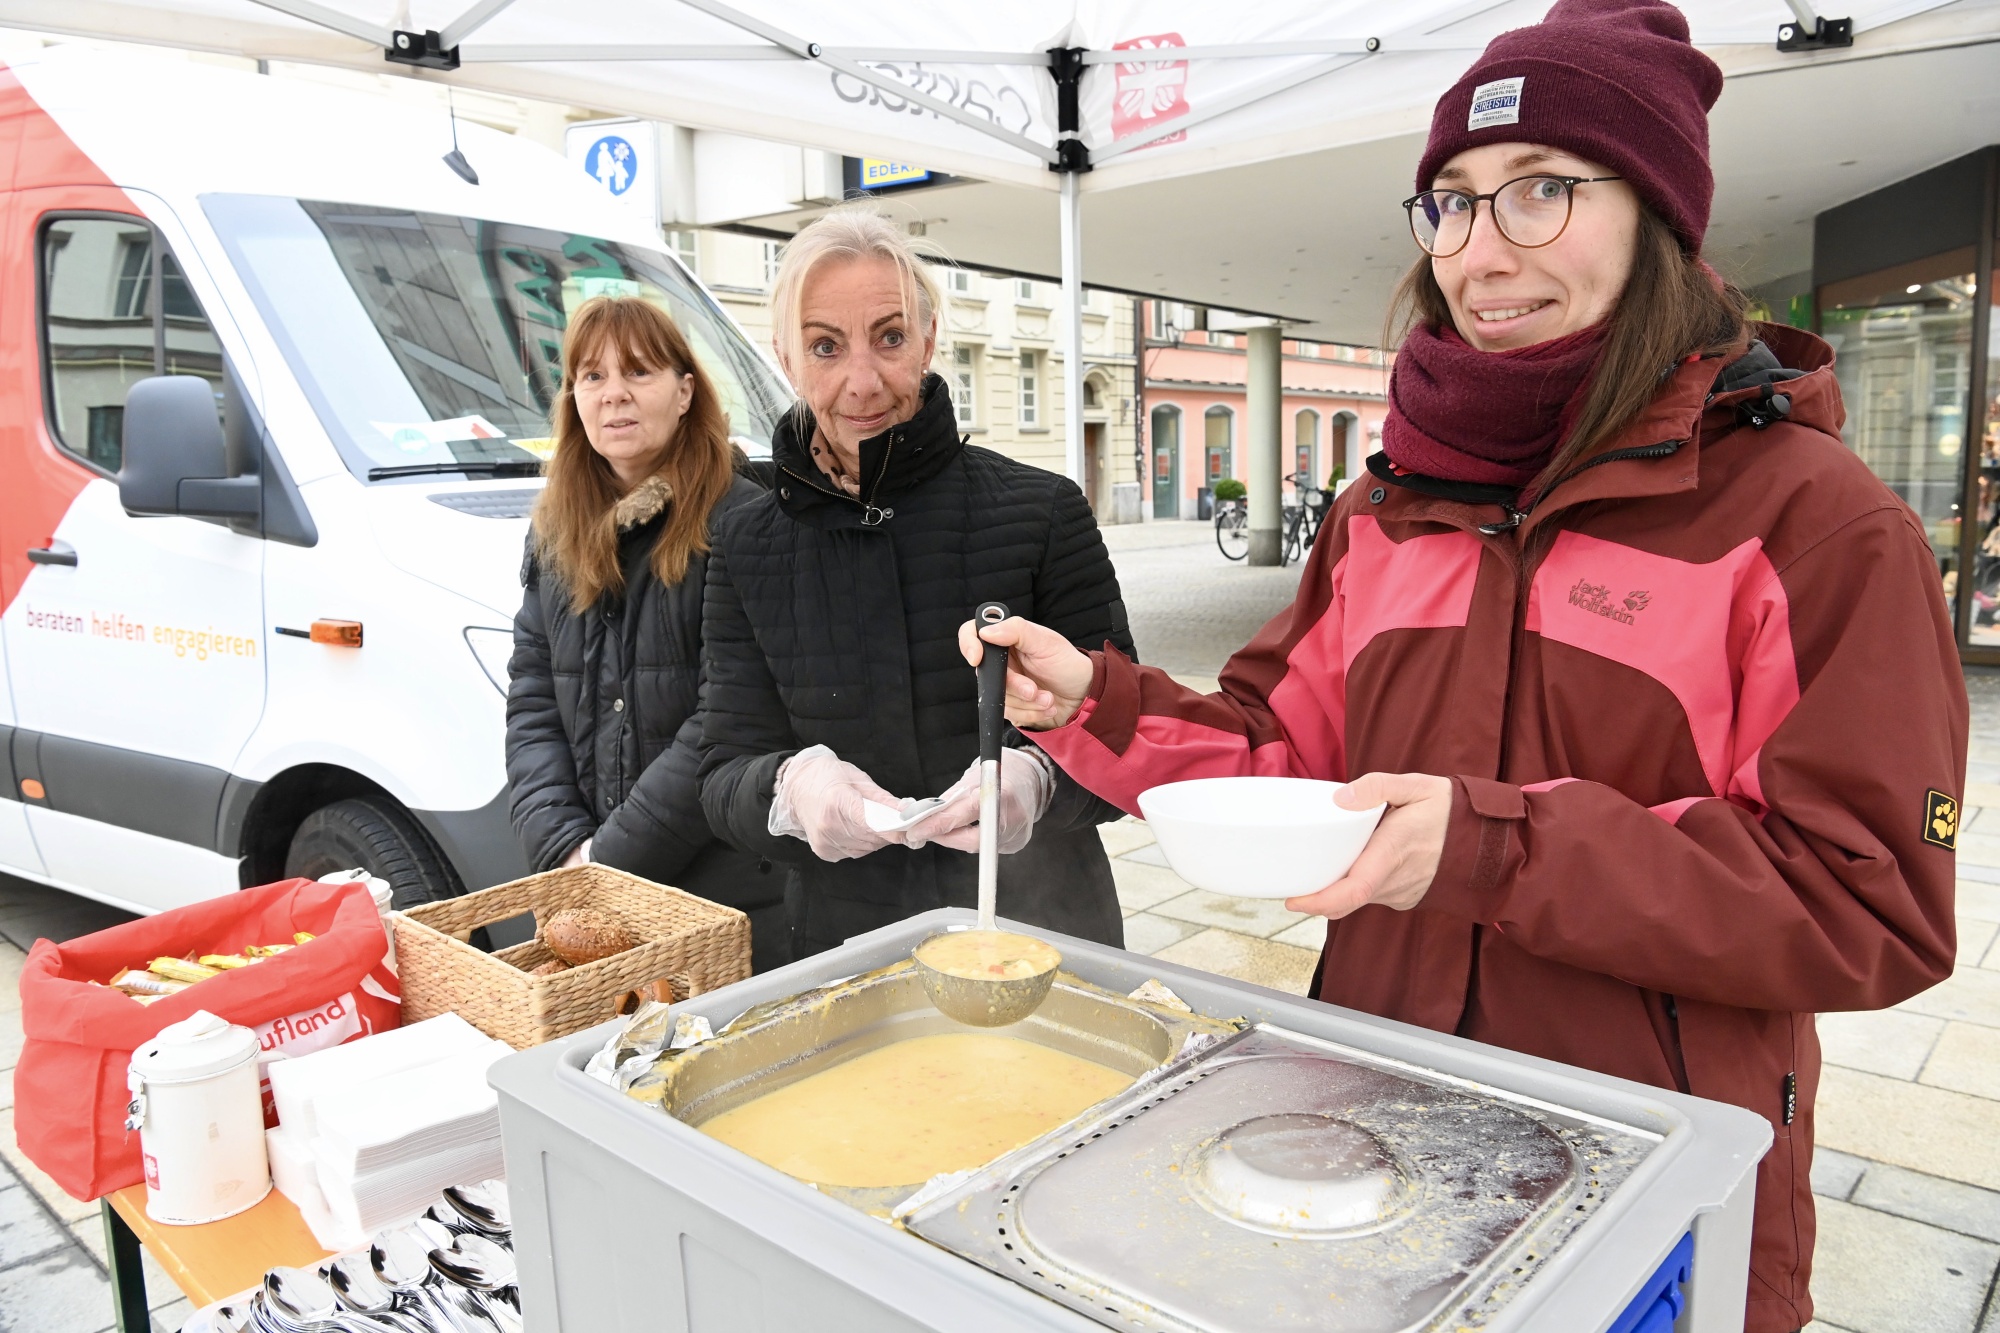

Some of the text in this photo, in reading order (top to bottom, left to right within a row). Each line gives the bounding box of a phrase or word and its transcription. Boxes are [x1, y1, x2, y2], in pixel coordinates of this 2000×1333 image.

[1474, 96, 1517, 113] STREETSTYLE
[869, 163, 922, 178] EDEK
[1571, 578, 1611, 601] Jack
[1567, 590, 1635, 626] Wolfskin
[26, 603, 257, 661] beraten helfen engagieren
[259, 999, 347, 1052] ufland
